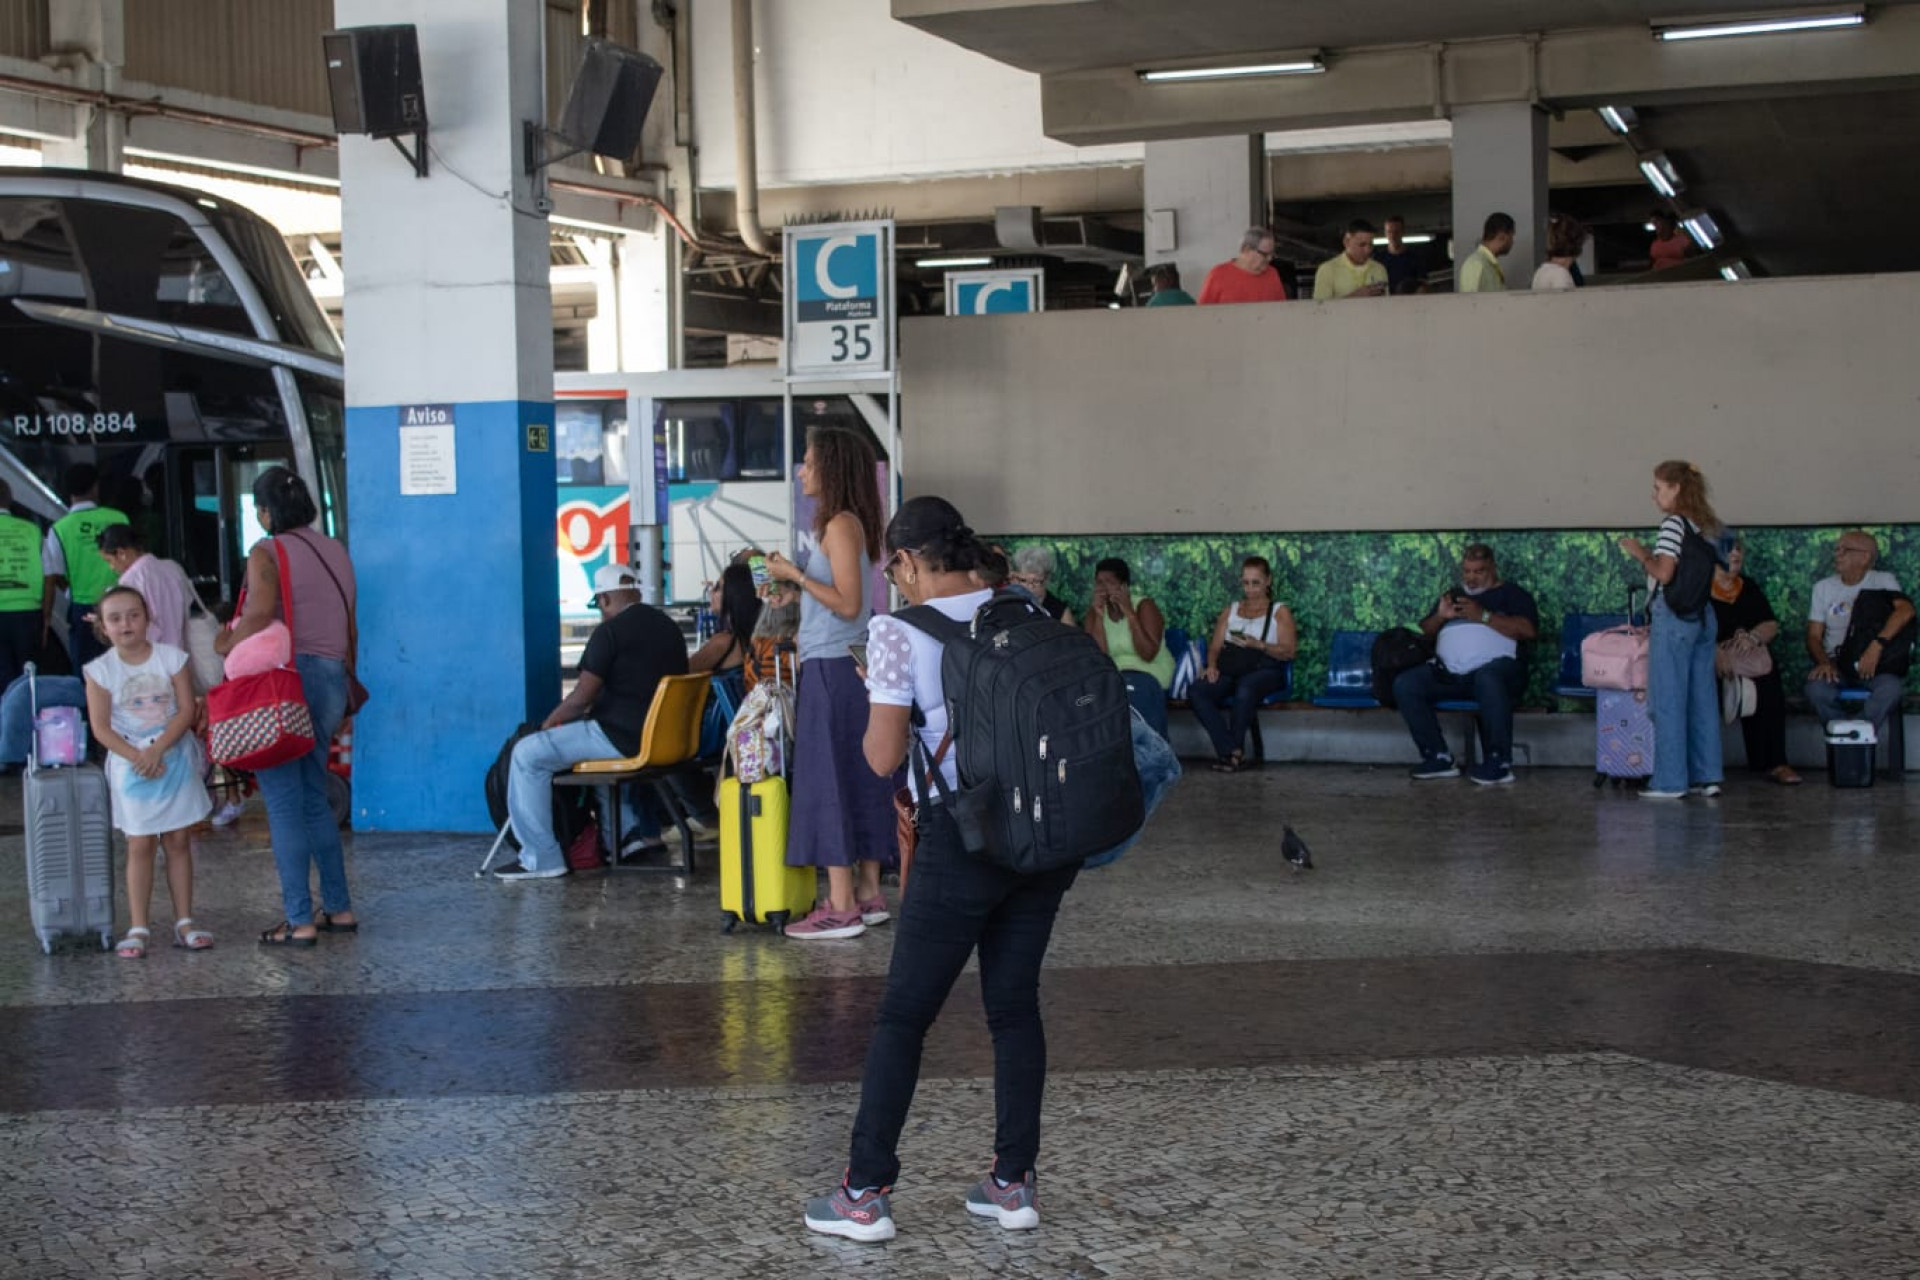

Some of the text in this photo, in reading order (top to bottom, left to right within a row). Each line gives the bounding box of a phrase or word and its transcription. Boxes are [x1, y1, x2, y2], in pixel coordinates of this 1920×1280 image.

[815, 235, 858, 299] C
[825, 300, 871, 312] Plataforma
[831, 323, 872, 362] 35
[14, 411, 136, 436] RJ 108.884
[407, 405, 446, 425] Aviso
[556, 500, 630, 567] 01
